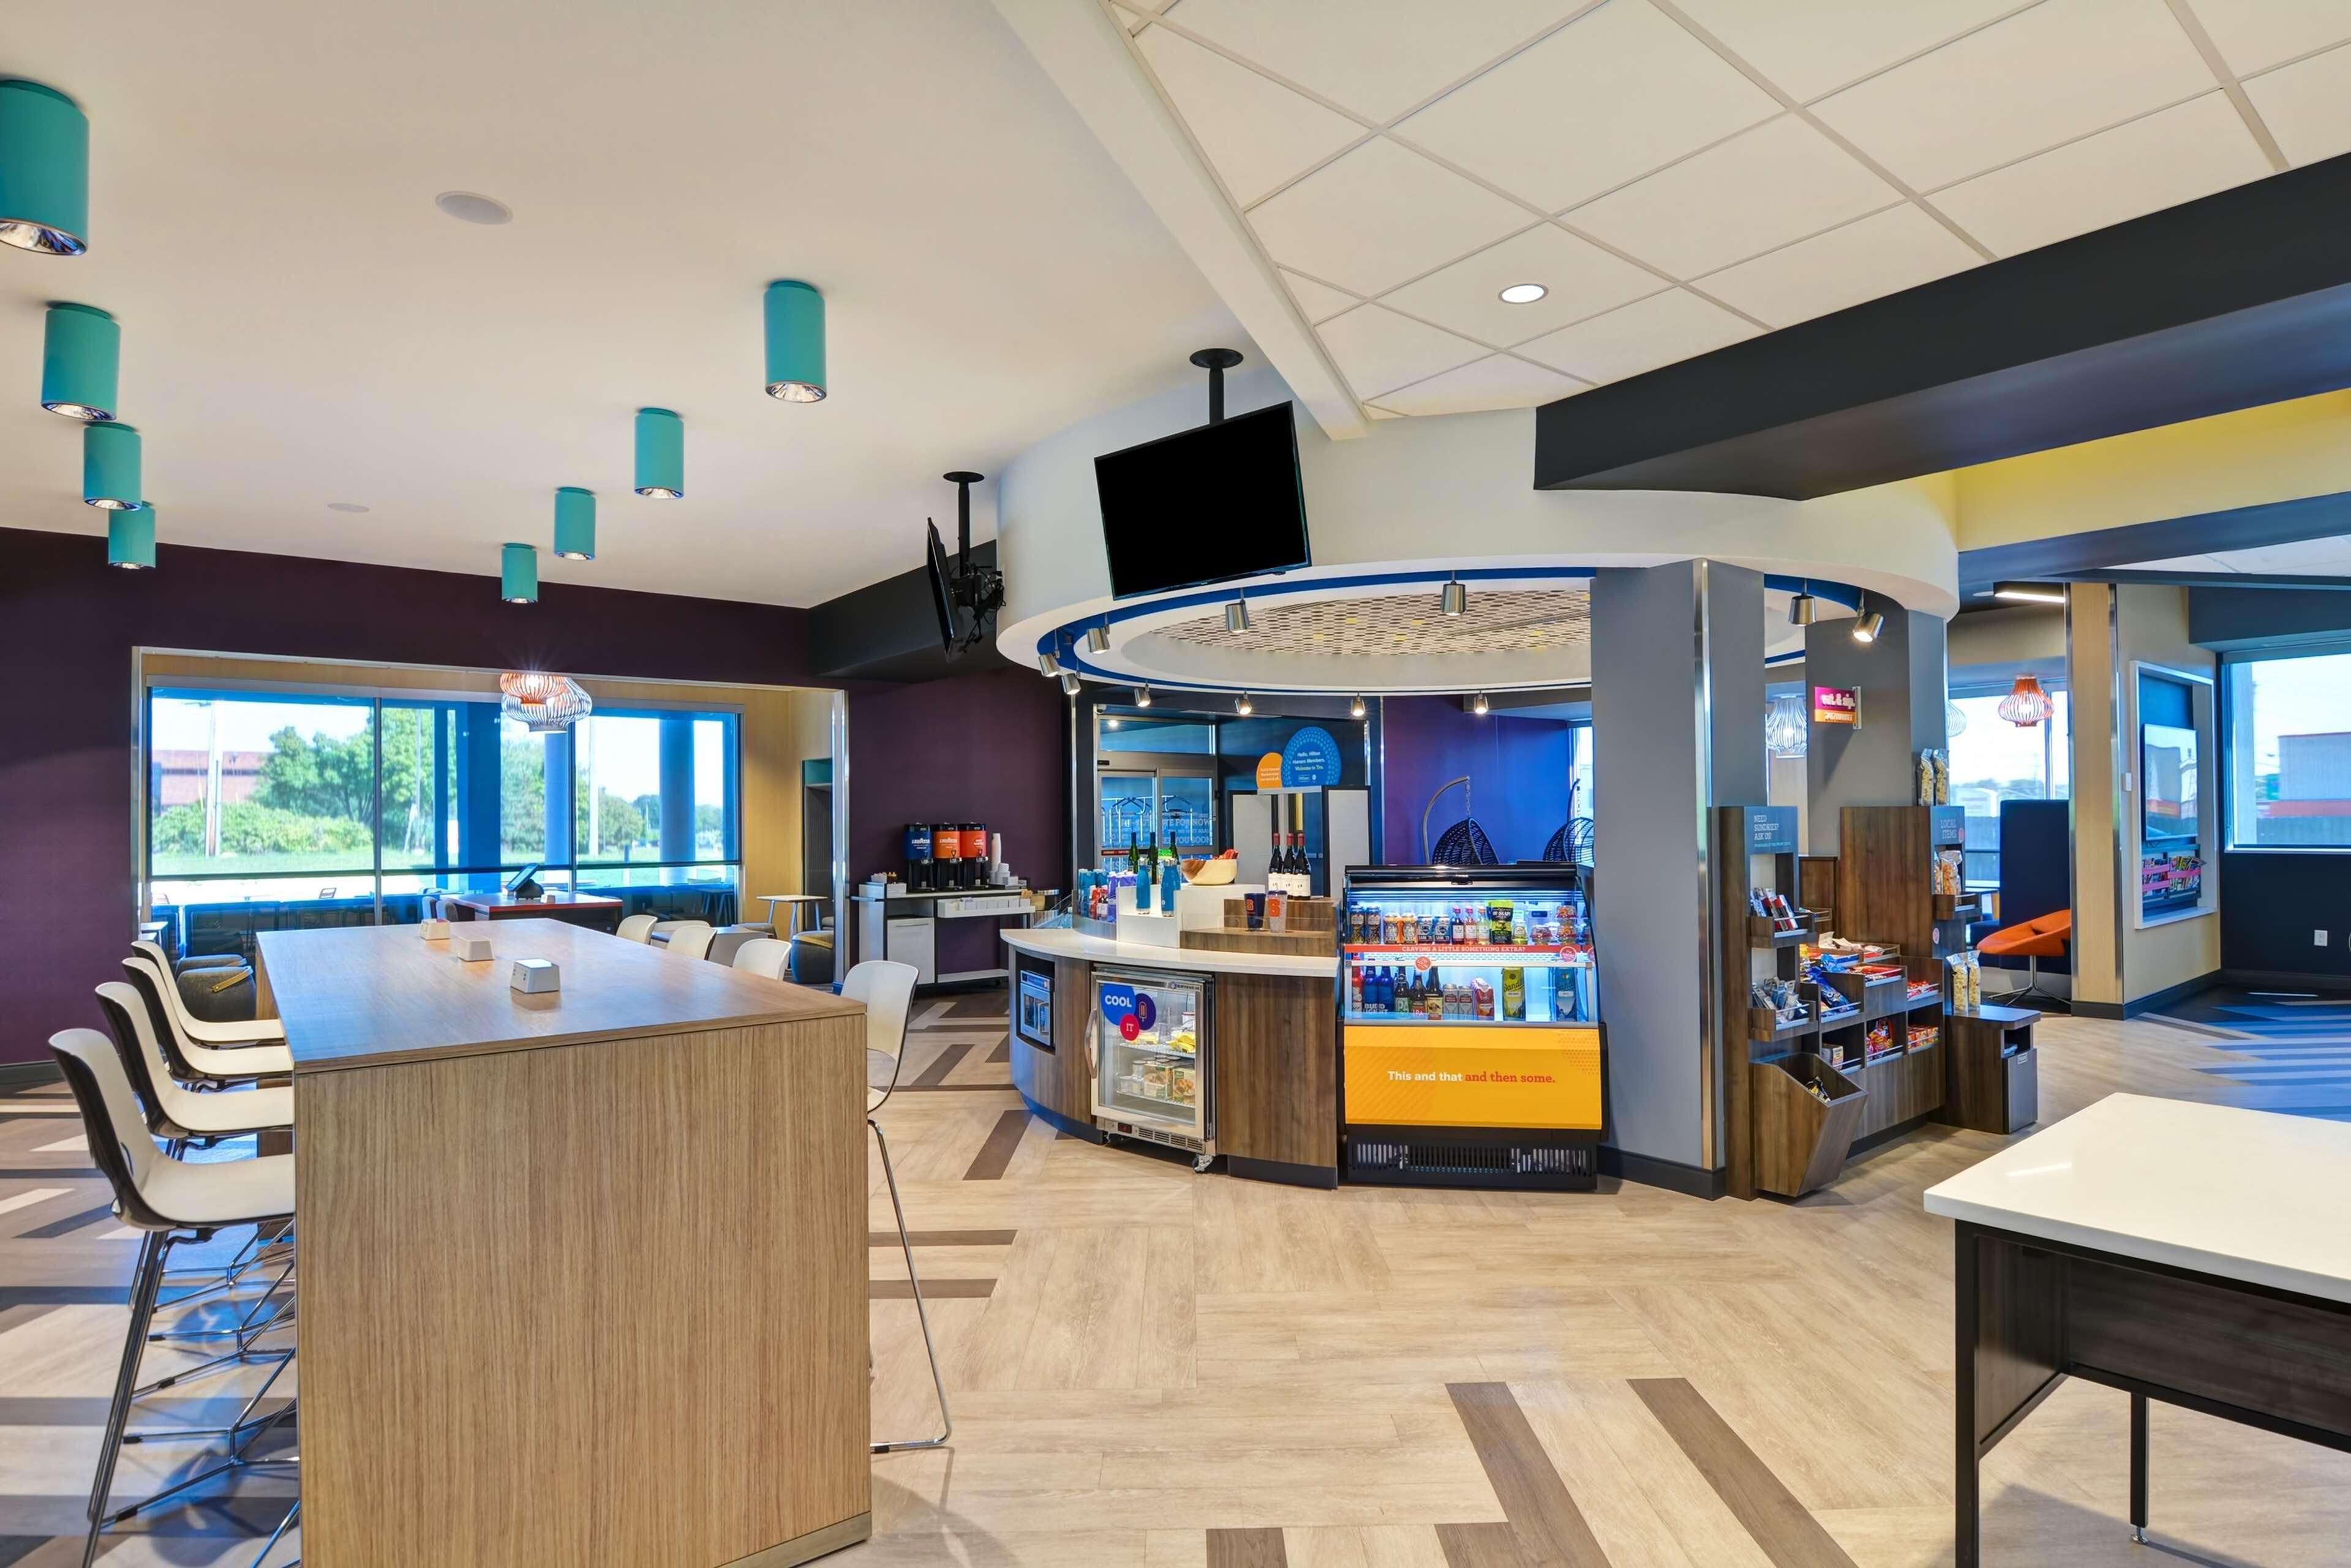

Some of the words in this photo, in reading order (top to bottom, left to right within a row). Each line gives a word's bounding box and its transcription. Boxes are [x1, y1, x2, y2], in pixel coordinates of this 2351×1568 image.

[1754, 823, 1779, 831] SUNDRIES?
[1940, 819, 1957, 828] LOCAL
[1942, 829, 1957, 839] ITEMS
[1268, 898, 1280, 917] S
[1105, 995, 1132, 1008] COOL
[1126, 1023, 1134, 1032] IT
[1387, 1071, 1412, 1081] This
[1415, 1071, 1436, 1081] and
[1439, 1072, 1462, 1082] that
[1465, 1071, 1487, 1082] and
[1491, 1071, 1518, 1082] then
[1520, 1073, 1555, 1083] some.
